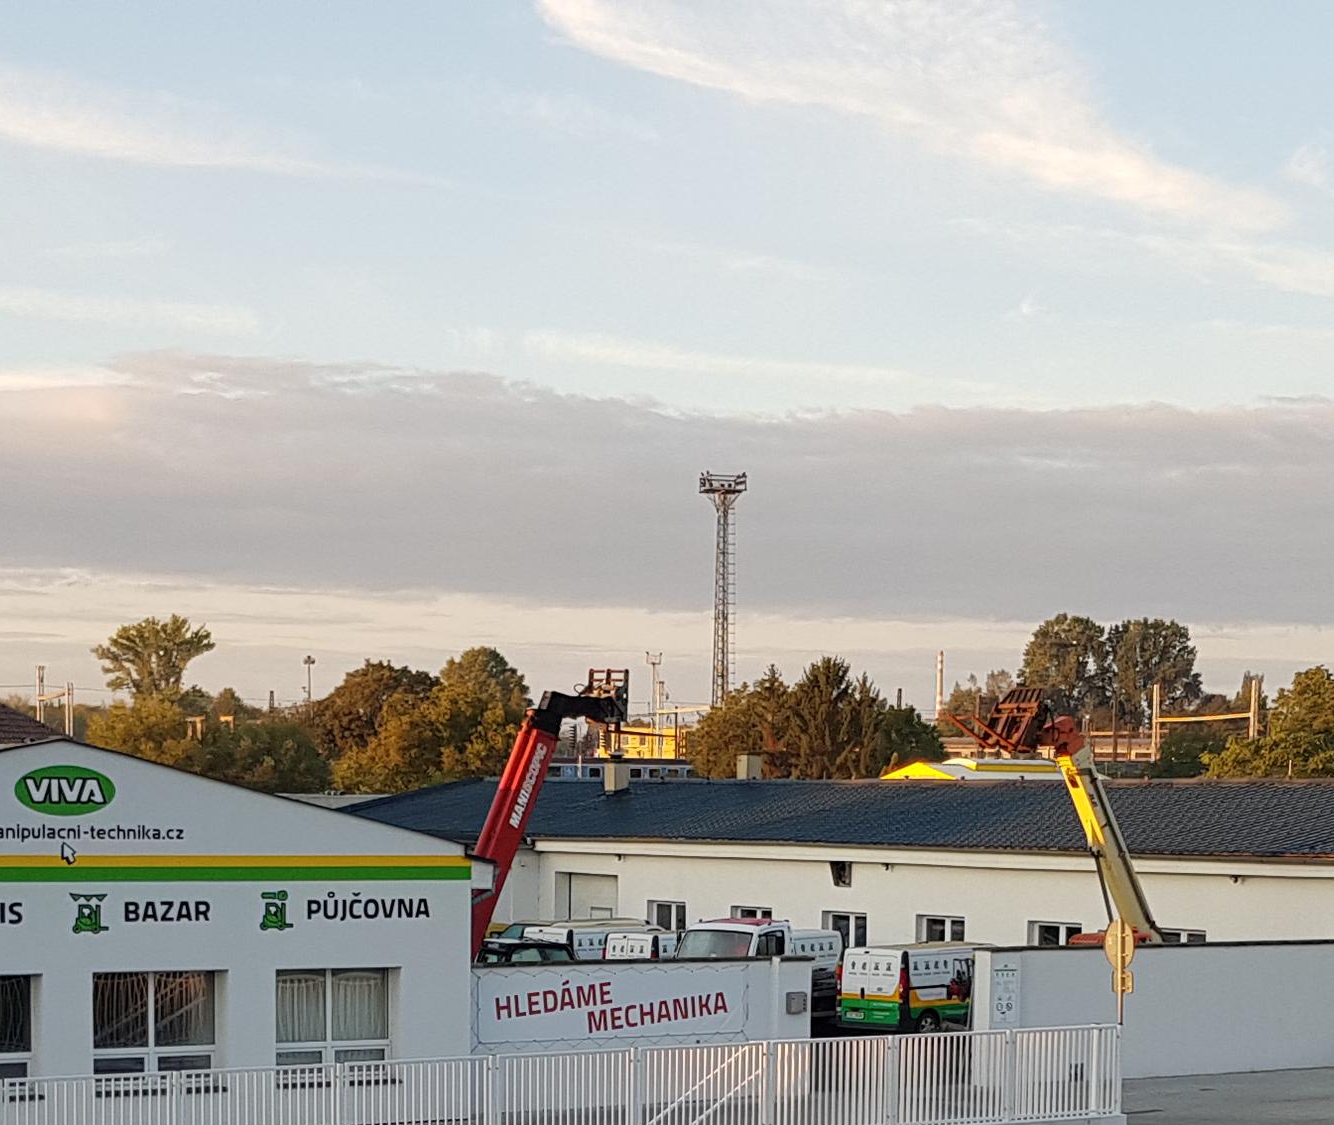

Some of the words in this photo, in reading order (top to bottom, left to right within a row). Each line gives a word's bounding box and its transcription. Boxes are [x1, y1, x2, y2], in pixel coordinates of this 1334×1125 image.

[24, 777, 107, 804] VIVA
[124, 901, 211, 922] BAZAR
[307, 891, 430, 920] PŮJČOVNA
[495, 980, 613, 1020] HLEDÁME
[587, 992, 728, 1033] MECHANIKA
